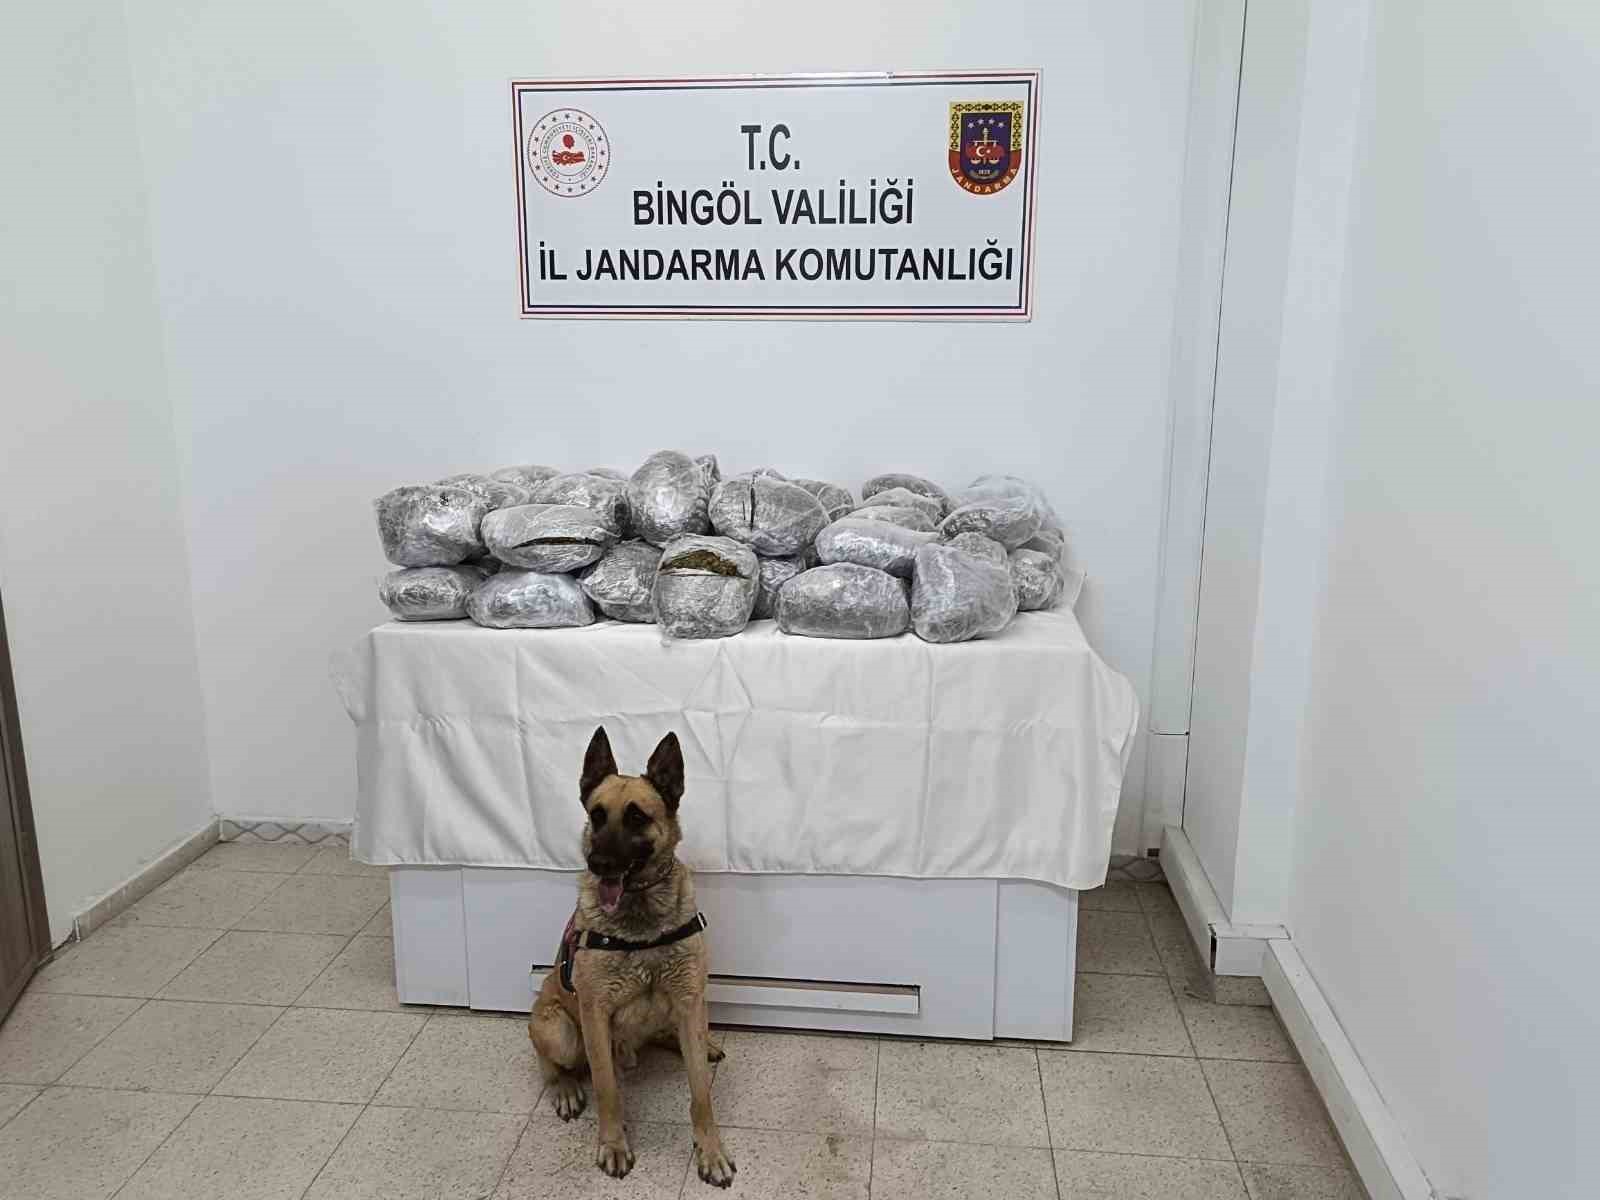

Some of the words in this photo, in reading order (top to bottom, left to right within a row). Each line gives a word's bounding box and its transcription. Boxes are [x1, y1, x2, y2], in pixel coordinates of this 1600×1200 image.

[741, 124, 800, 171] T.C.
[633, 180, 762, 226] BİNGÖL
[771, 178, 913, 225] VALİLİĞİ
[952, 167, 1018, 193] JANDARMA
[539, 240, 568, 281] İL
[576, 248, 766, 281] JANDARMA
[775, 238, 1013, 281] KOMUTANLIĞI
